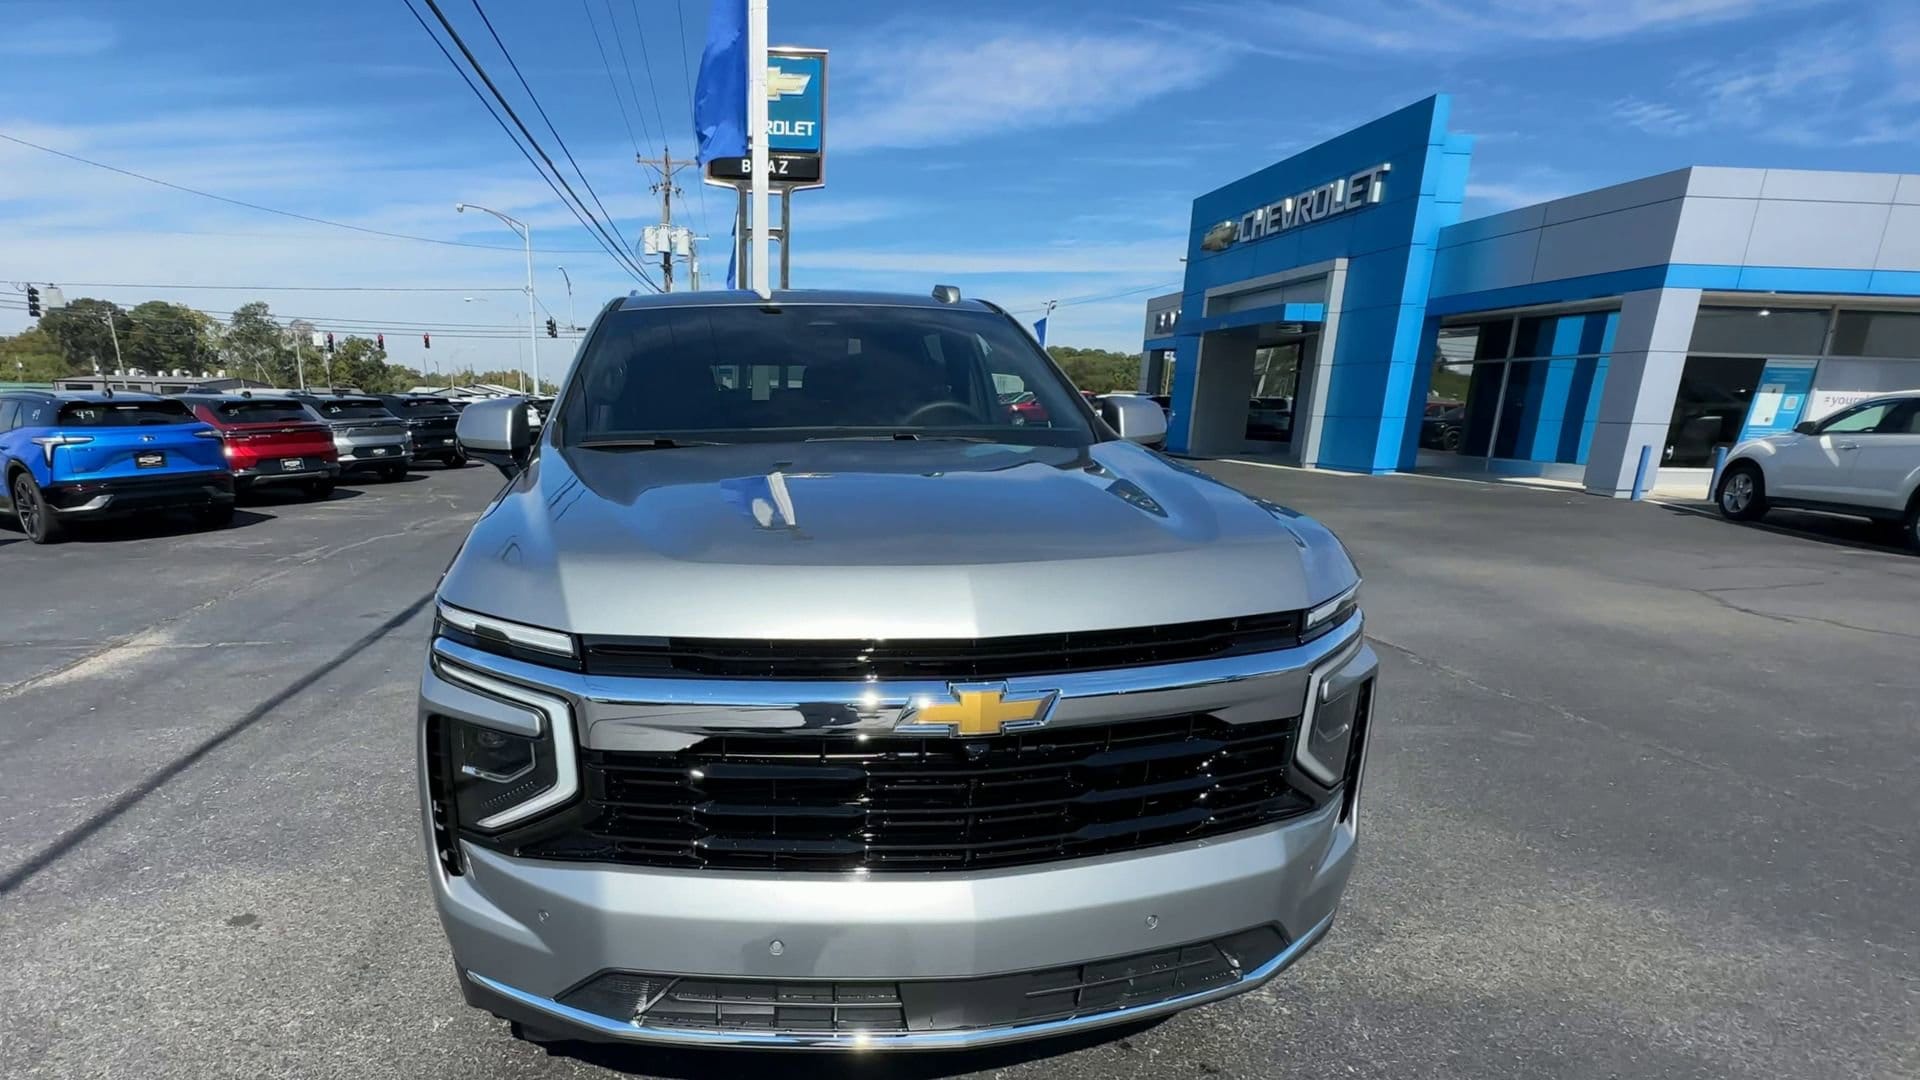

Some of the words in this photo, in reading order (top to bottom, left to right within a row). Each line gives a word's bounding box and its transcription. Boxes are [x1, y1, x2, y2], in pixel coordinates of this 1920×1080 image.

[766, 119, 816, 136] ROLET
[741, 159, 789, 174] BAZ
[1238, 163, 1391, 242] CHEVROLET
